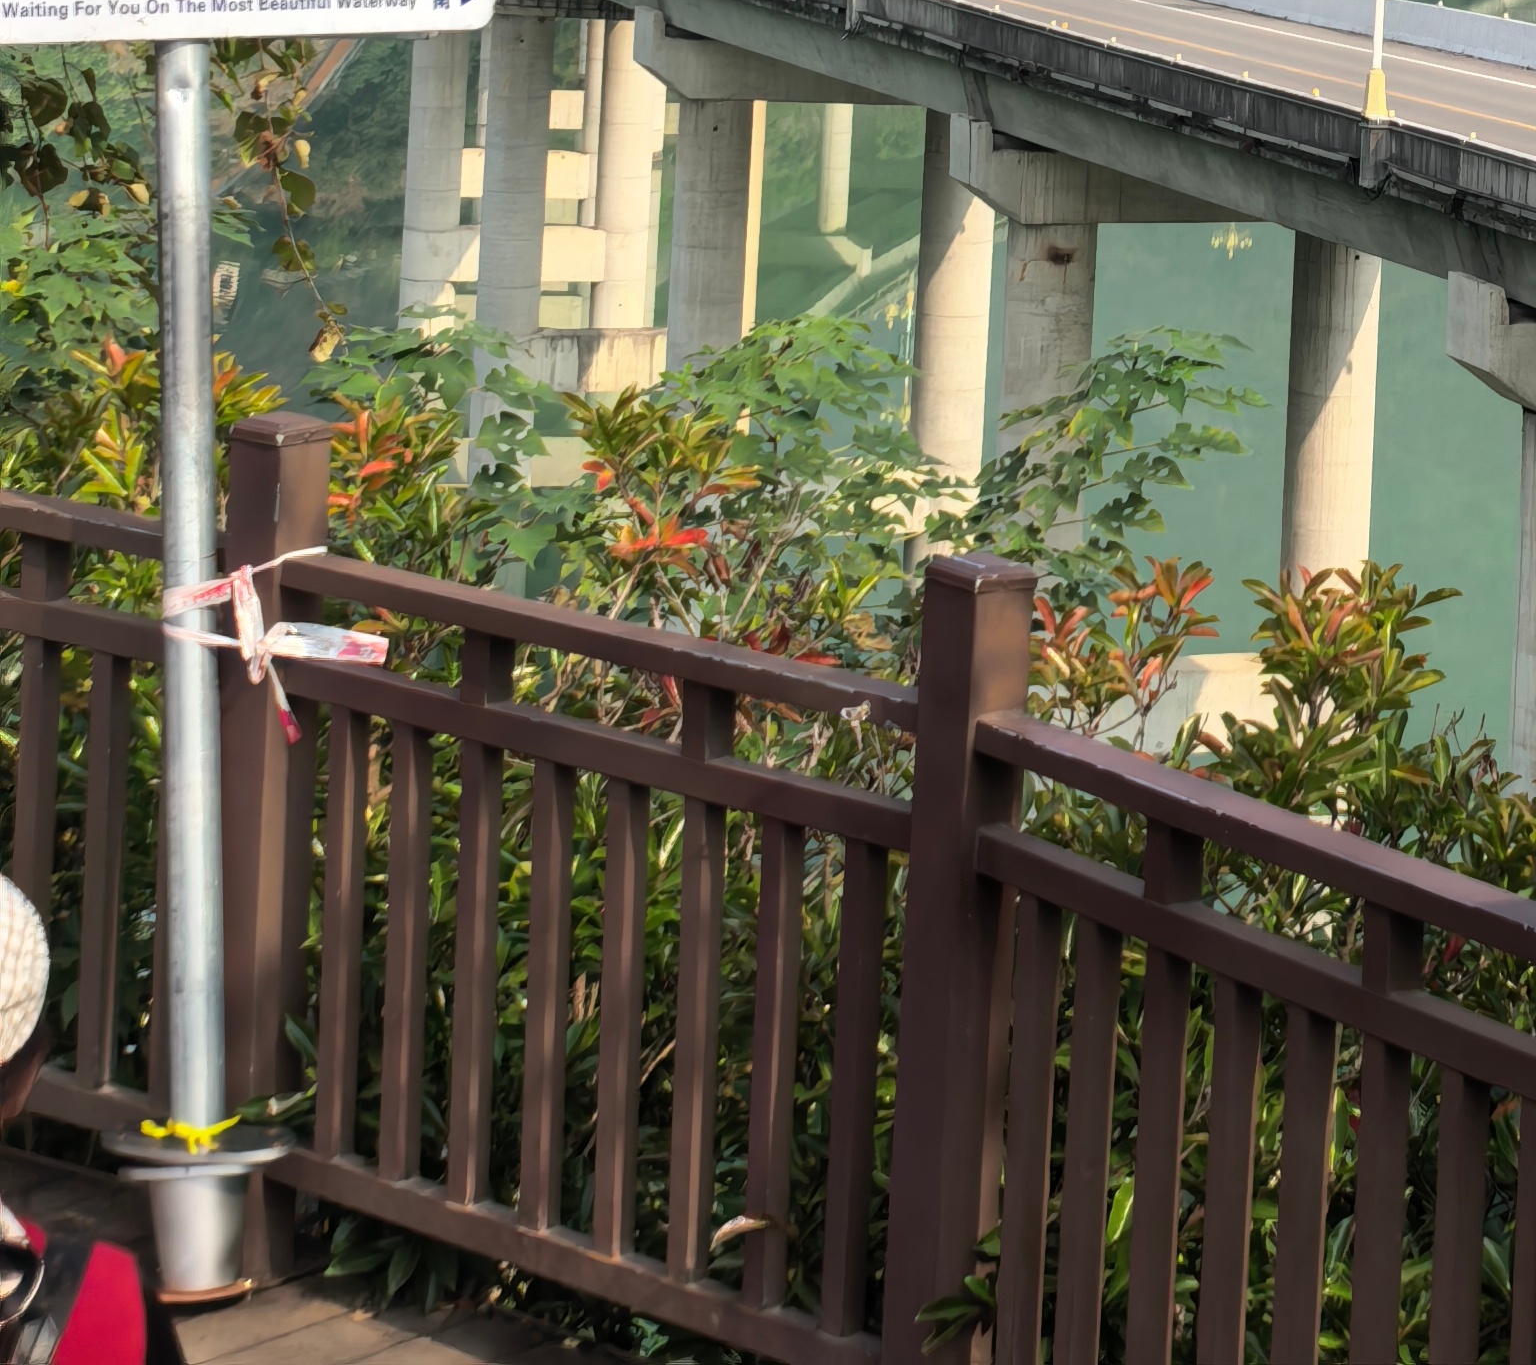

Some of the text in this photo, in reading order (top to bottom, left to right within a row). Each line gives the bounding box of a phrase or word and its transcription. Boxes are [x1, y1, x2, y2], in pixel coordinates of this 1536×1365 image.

[2, 2, 69, 20] Waiting
[74, 0, 102, 17] For
[107, 0, 140, 15] You
